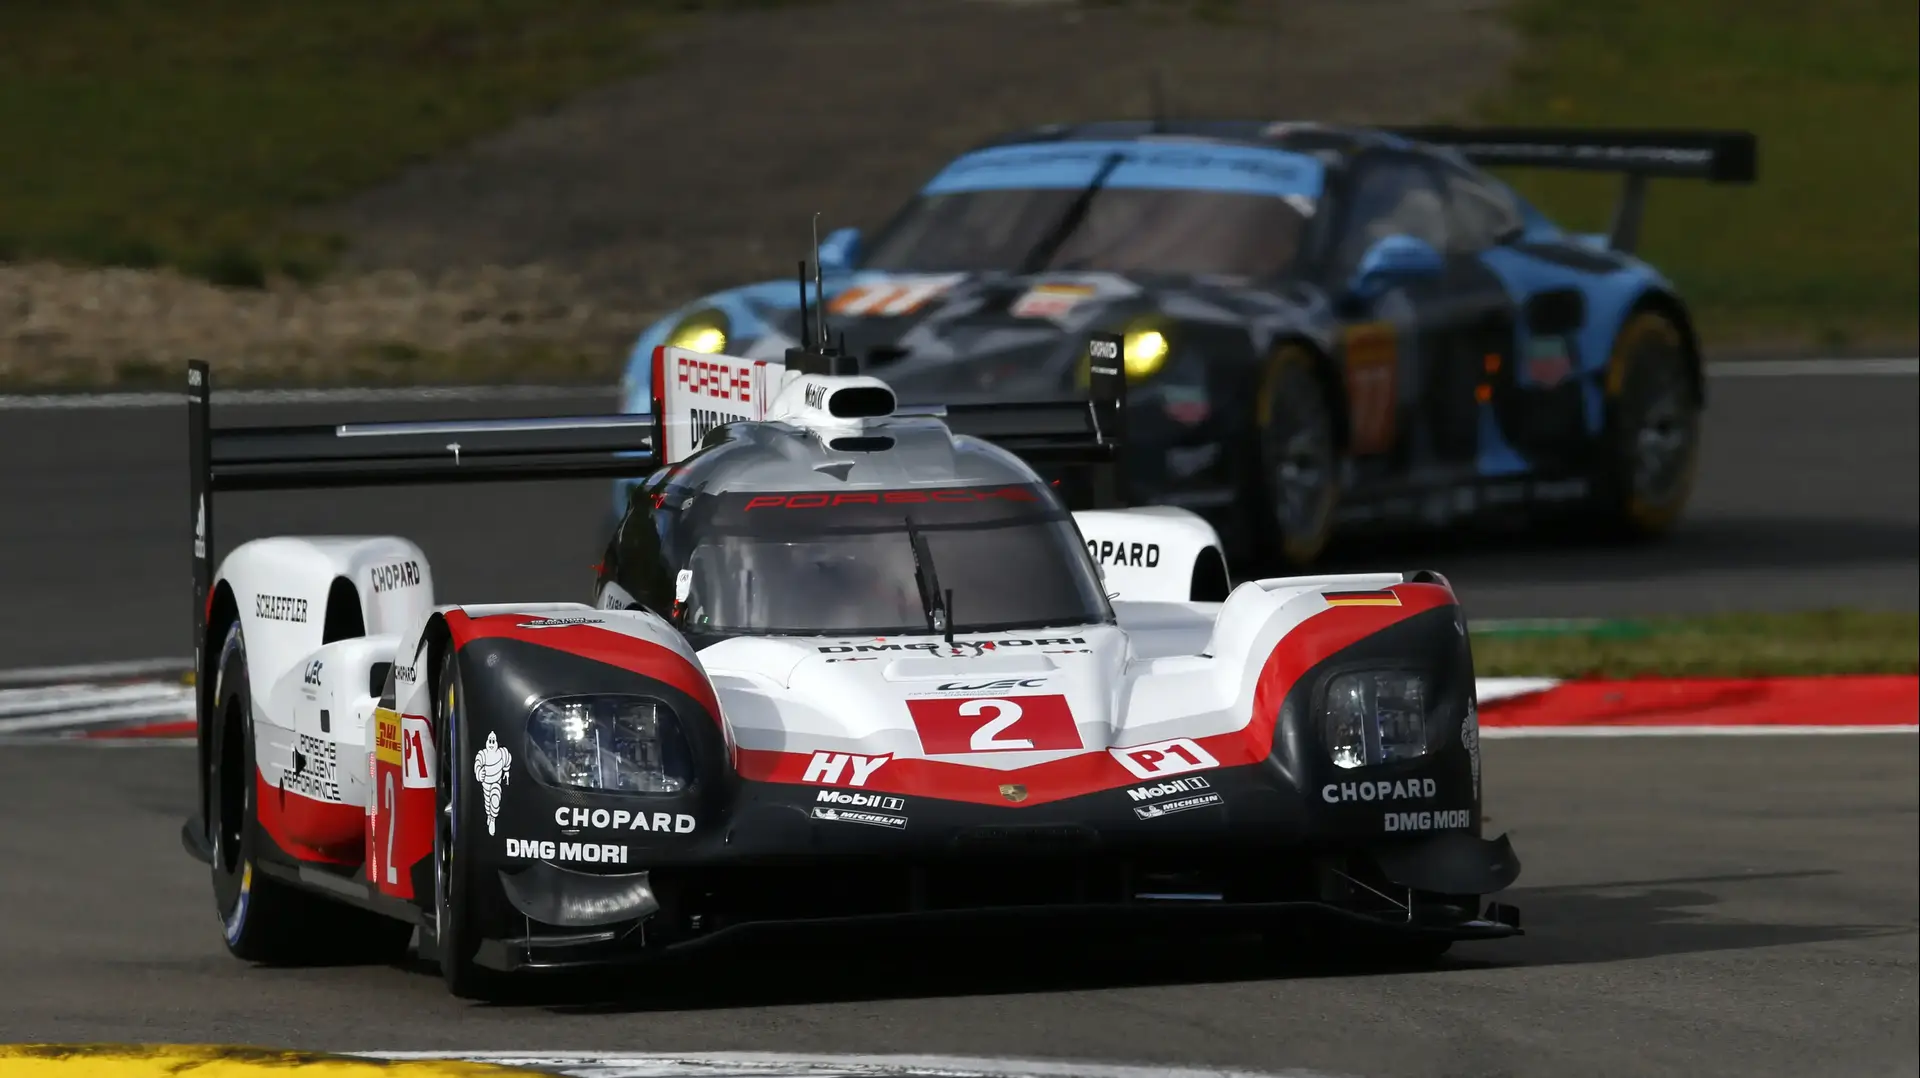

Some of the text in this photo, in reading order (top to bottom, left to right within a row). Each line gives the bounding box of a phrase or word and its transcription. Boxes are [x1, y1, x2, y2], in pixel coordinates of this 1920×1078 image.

[678, 358, 750, 402] PORSCHE
[744, 488, 1036, 511] PORSCHE
[371, 561, 420, 593] CHOPARD
[255, 593, 308, 623] SCHAEFFLER
[817, 637, 1087, 654] DMG MORI
[304, 660, 323, 686] WEC
[936, 677, 1048, 691] WEC
[958, 698, 1035, 751] 2
[300, 734, 336, 760] PORSCHE
[403, 728, 429, 779] P1
[1127, 744, 1202, 773] P1
[802, 752, 890, 786] HY
[284, 769, 342, 801] PERFORMANCE
[1126, 780, 1190, 801] Mobil
[1322, 778, 1436, 803] CHOPARD
[816, 790, 882, 808] Mobil
[1162, 795, 1218, 811] MICHELIN
[384, 771, 398, 884] 2
[555, 806, 696, 834] CHOPARD
[840, 811, 905, 825] MICHELIN
[1384, 809, 1470, 832] DMG MORI
[506, 838, 628, 864] DMG MORI
